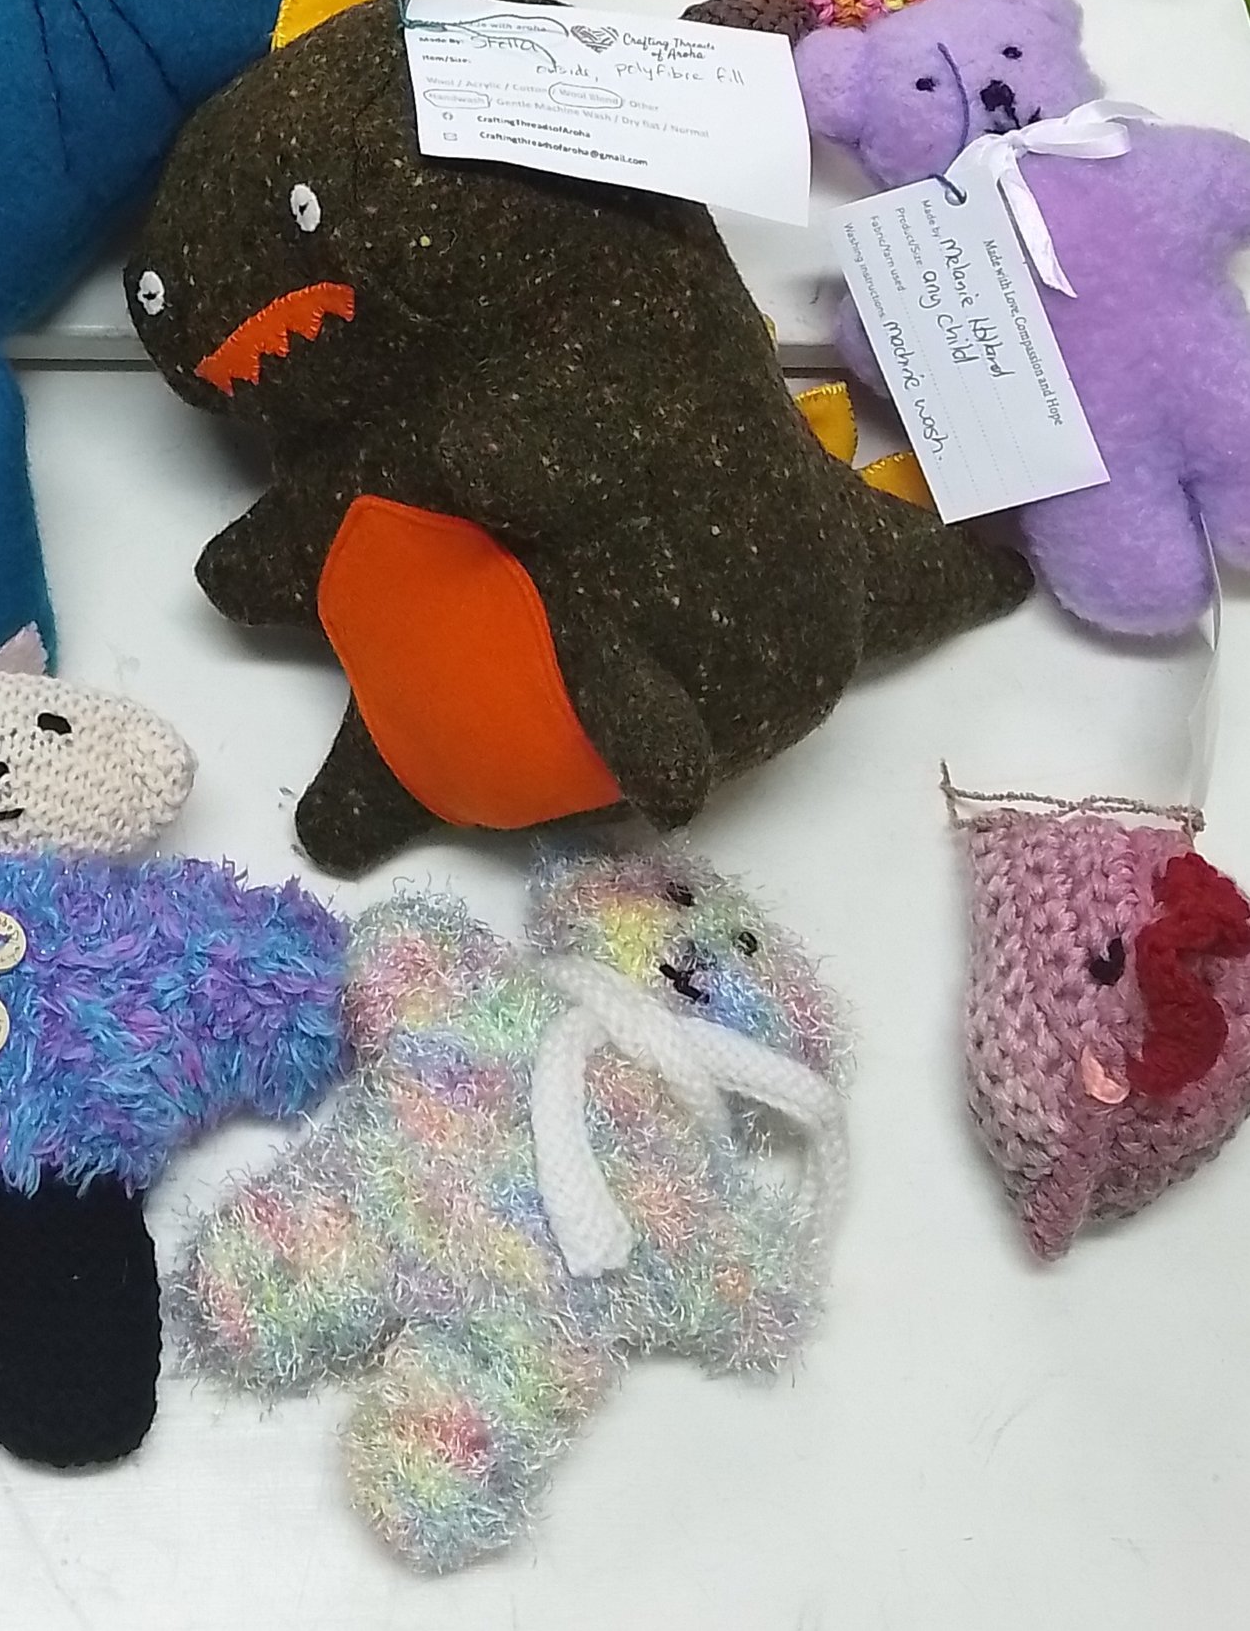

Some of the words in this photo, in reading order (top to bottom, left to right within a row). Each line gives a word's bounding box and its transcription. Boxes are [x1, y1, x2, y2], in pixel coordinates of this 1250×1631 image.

[622, 32, 670, 51] Crafting
[673, 37, 716, 51] Threads
[651, 48, 664, 62] of
[667, 49, 706, 60] Aroha
[426, 76, 455, 86] Wool
[512, 83, 548, 94] Cotton
[559, 88, 587, 100] Wool
[589, 92, 619, 106] Blend
[629, 100, 659, 111] Other
[534, 102, 580, 117] Machine
[583, 108, 612, 122] Wash
[621, 116, 641, 129] Dry
[670, 124, 710, 139] Normal
[921, 199, 937, 228] Made
[843, 222, 864, 264] Washing
[895, 207, 923, 266] Product/Size
[983, 238, 1000, 265] Made
[870, 215, 895, 268] Fabric/Yarn
[891, 265, 907, 293] used
[918, 270, 943, 310] any
[996, 263, 1014, 290] with
[1003, 288, 1019, 318] Love,
[1012, 315, 1043, 377] Compassion
[1034, 374, 1051, 399] and
[1045, 394, 1064, 427] Hope
